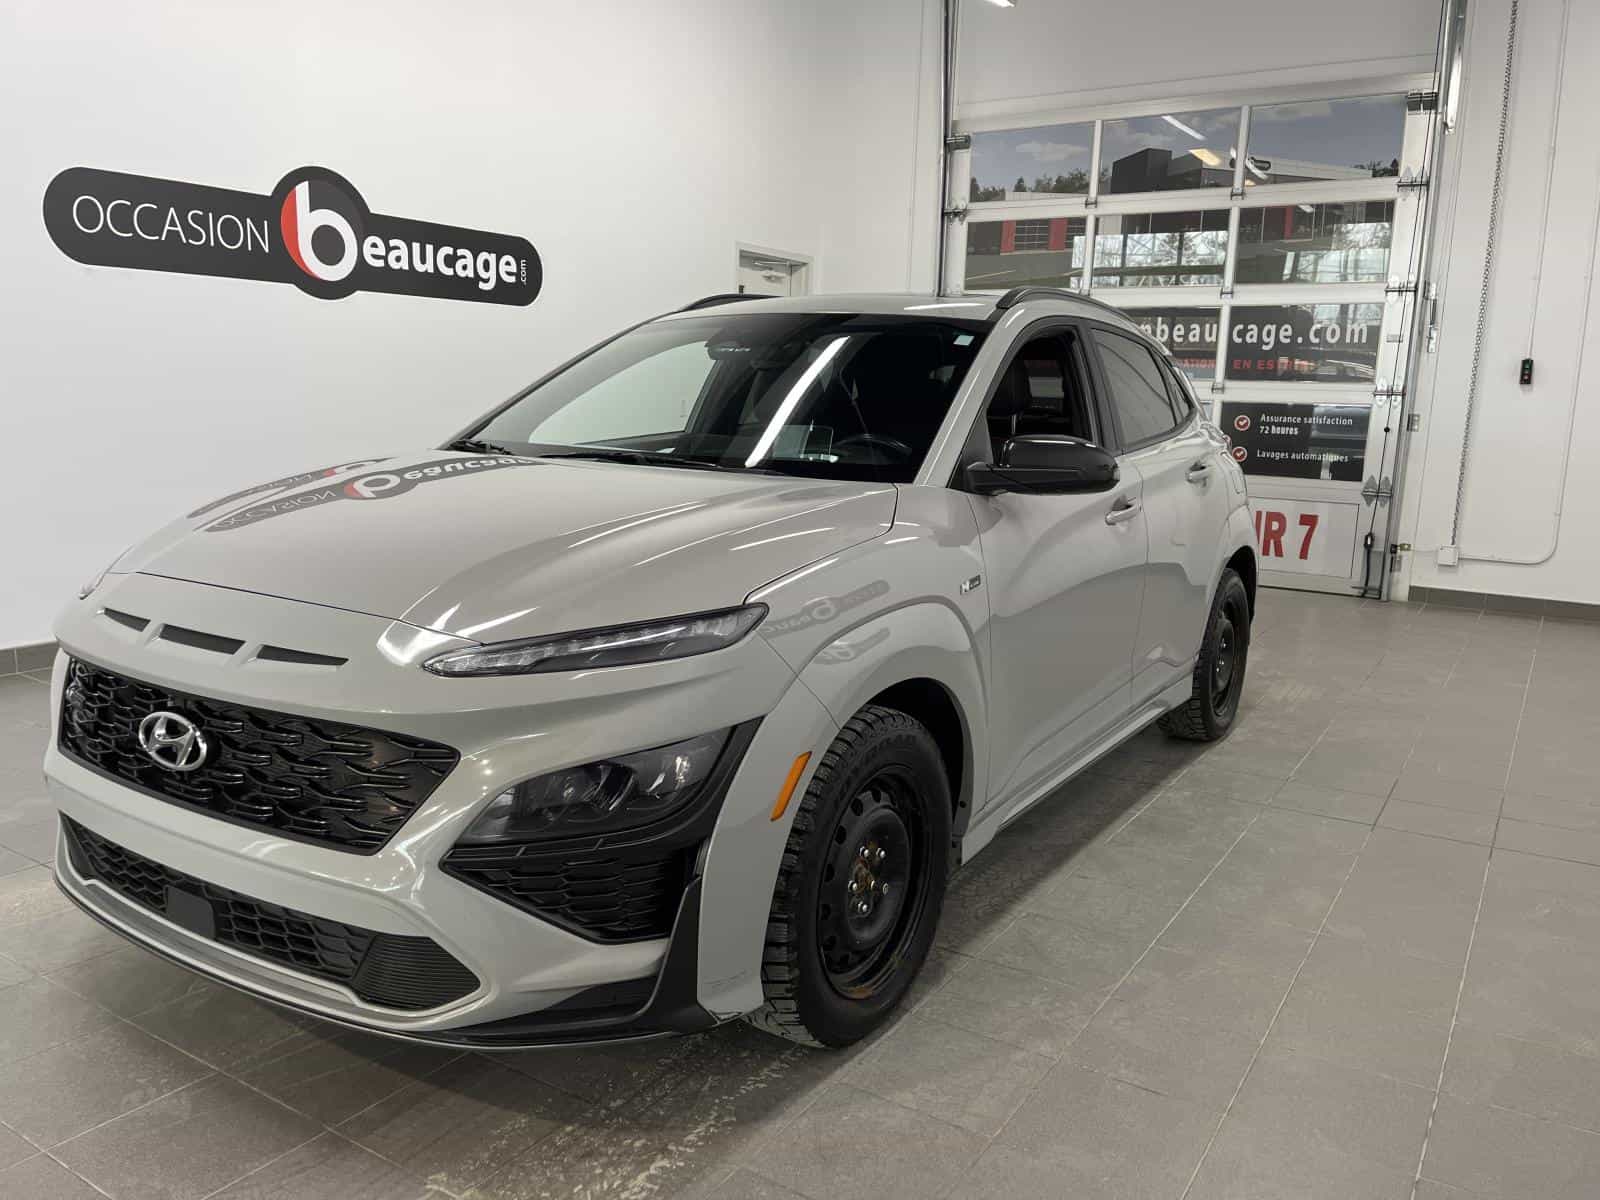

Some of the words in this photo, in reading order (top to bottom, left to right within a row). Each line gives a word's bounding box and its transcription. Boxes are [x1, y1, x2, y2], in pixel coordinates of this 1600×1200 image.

[73, 195, 269, 253] OCCASION
[1232, 359, 1252, 369] EN
[1260, 413, 1302, 424] Assurance
[1303, 416, 1353, 425] satisfaction
[1260, 426, 1270, 434] 72
[1271, 425, 1299, 435] heures
[1257, 449, 1289, 460] Lavages
[1291, 453, 1349, 463] automatiques
[1299, 514, 1319, 561] 7
